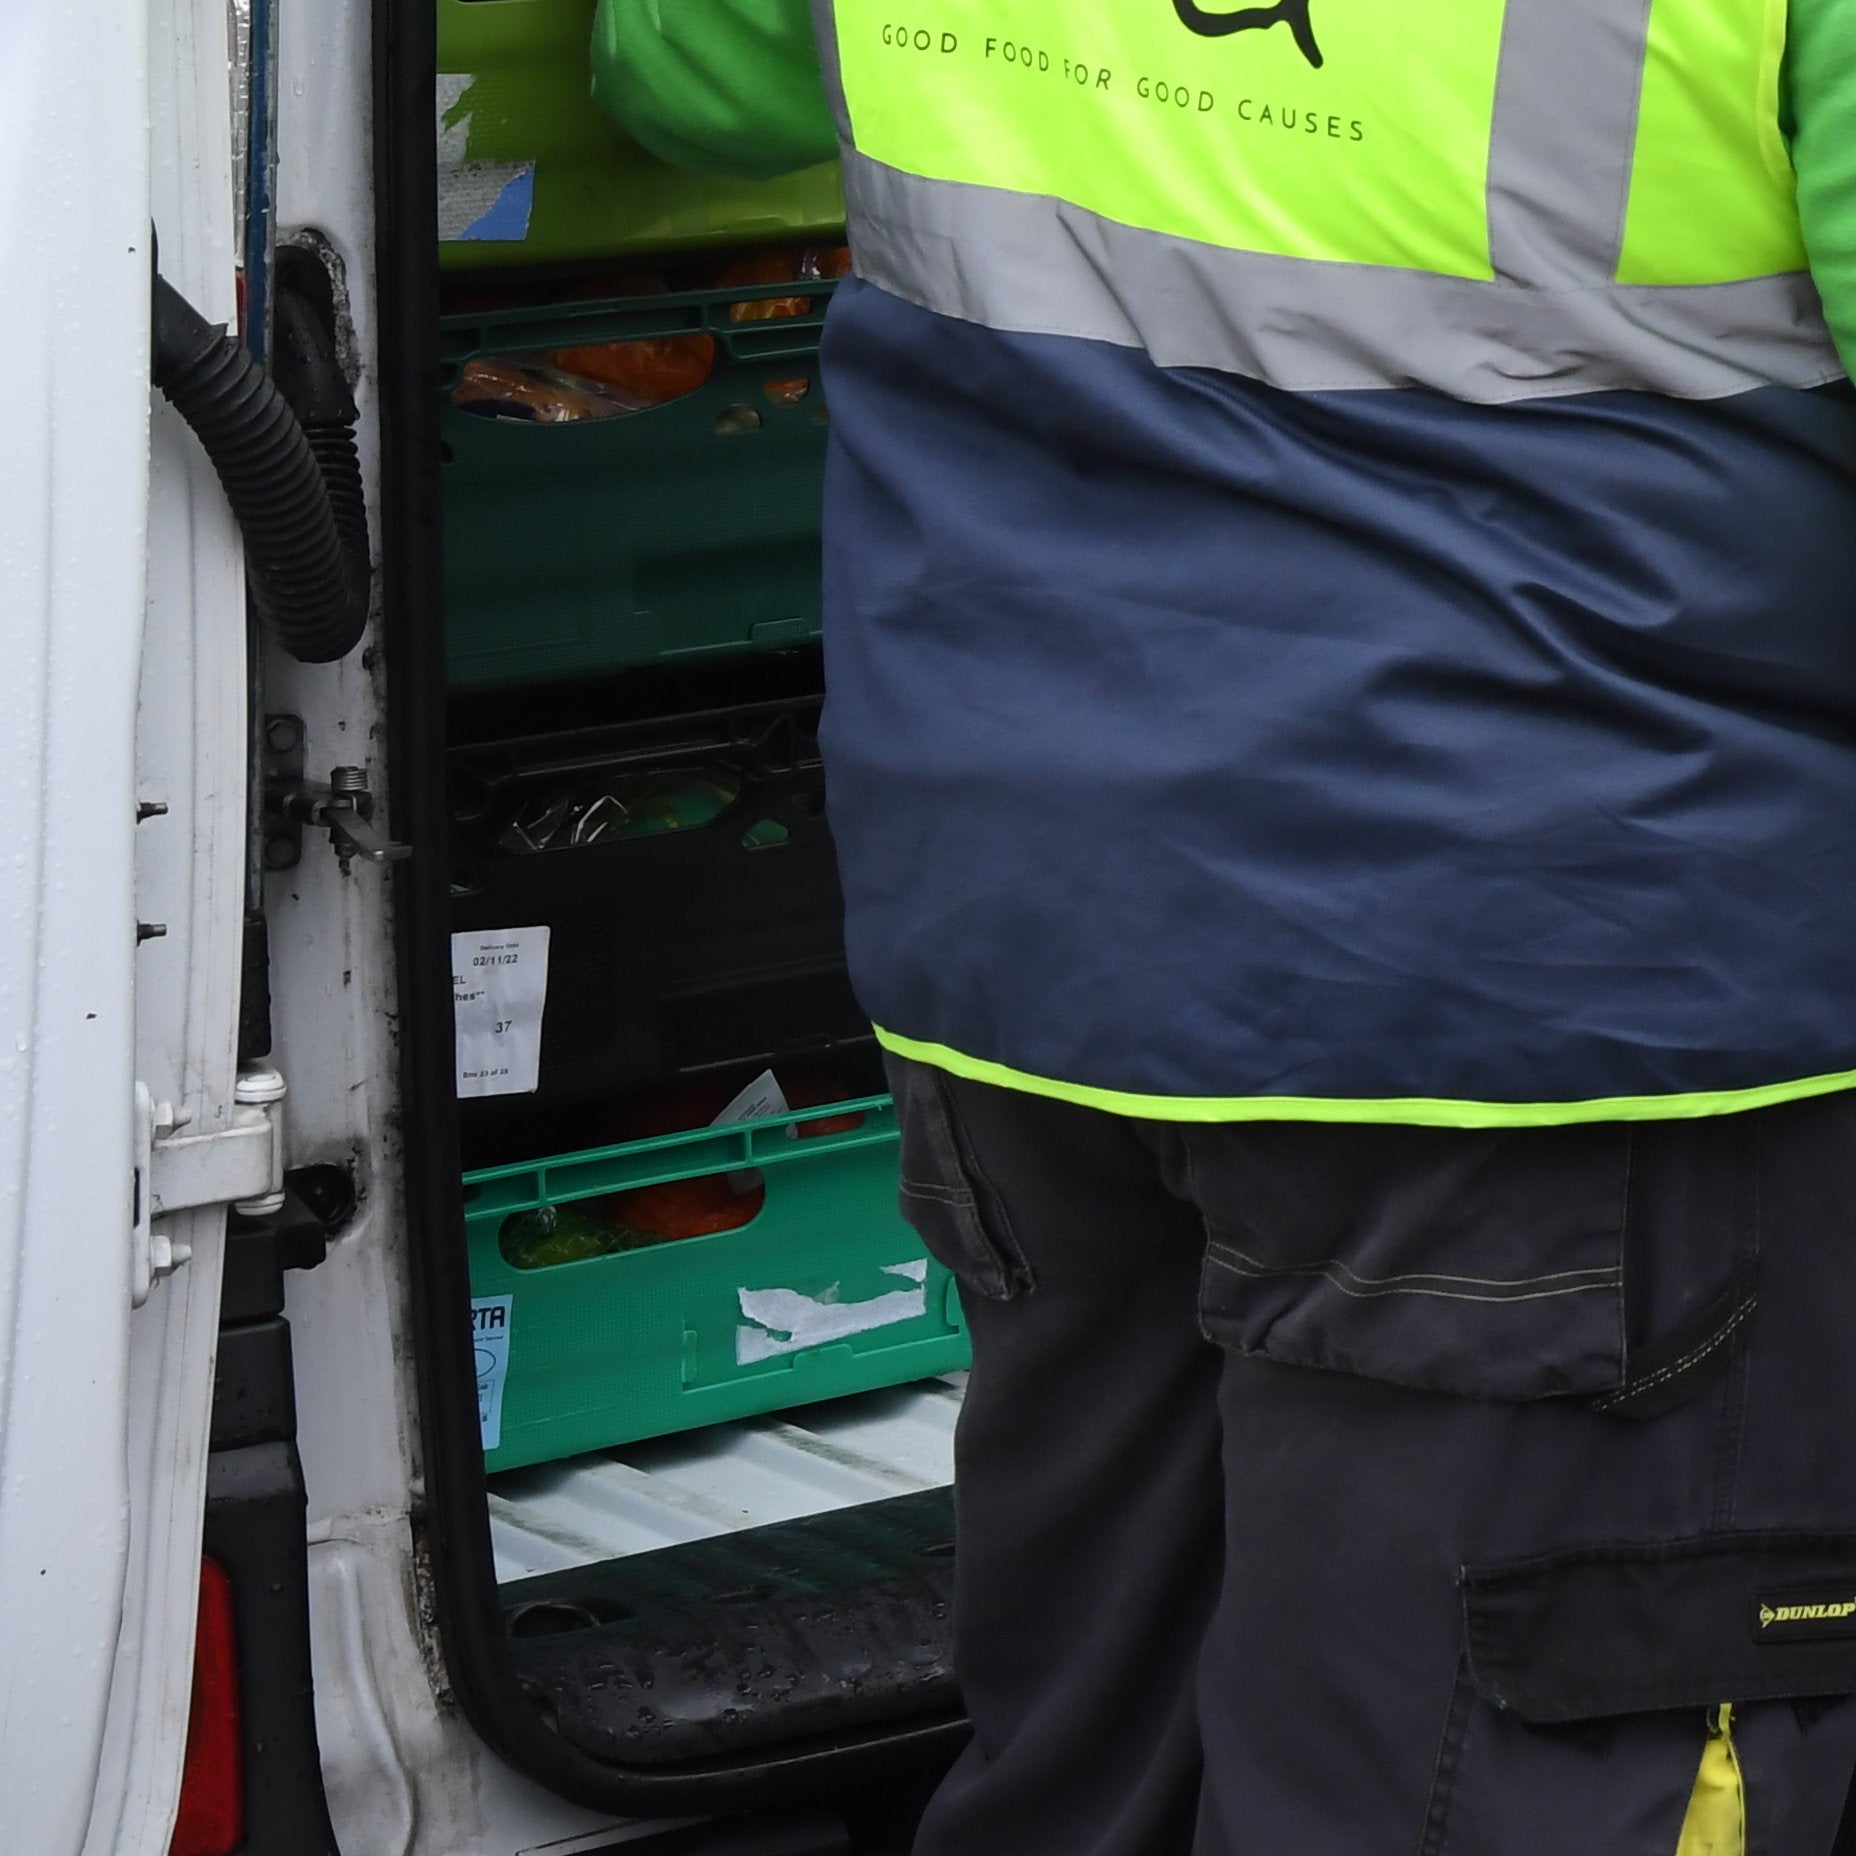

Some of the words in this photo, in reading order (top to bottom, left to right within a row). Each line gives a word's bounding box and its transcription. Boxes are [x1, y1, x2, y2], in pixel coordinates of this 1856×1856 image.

[881, 23, 958, 54] GOOD
[984, 36, 1050, 73] FOOD
[1063, 58, 1111, 91] FOR
[1136, 76, 1215, 113] GOOD
[1237, 98, 1365, 142] CAUSES
[472, 953, 519, 967] 02/11/22
[494, 1020, 512, 1034] 37
[1775, 1603, 1856, 1621] DUNLOP
